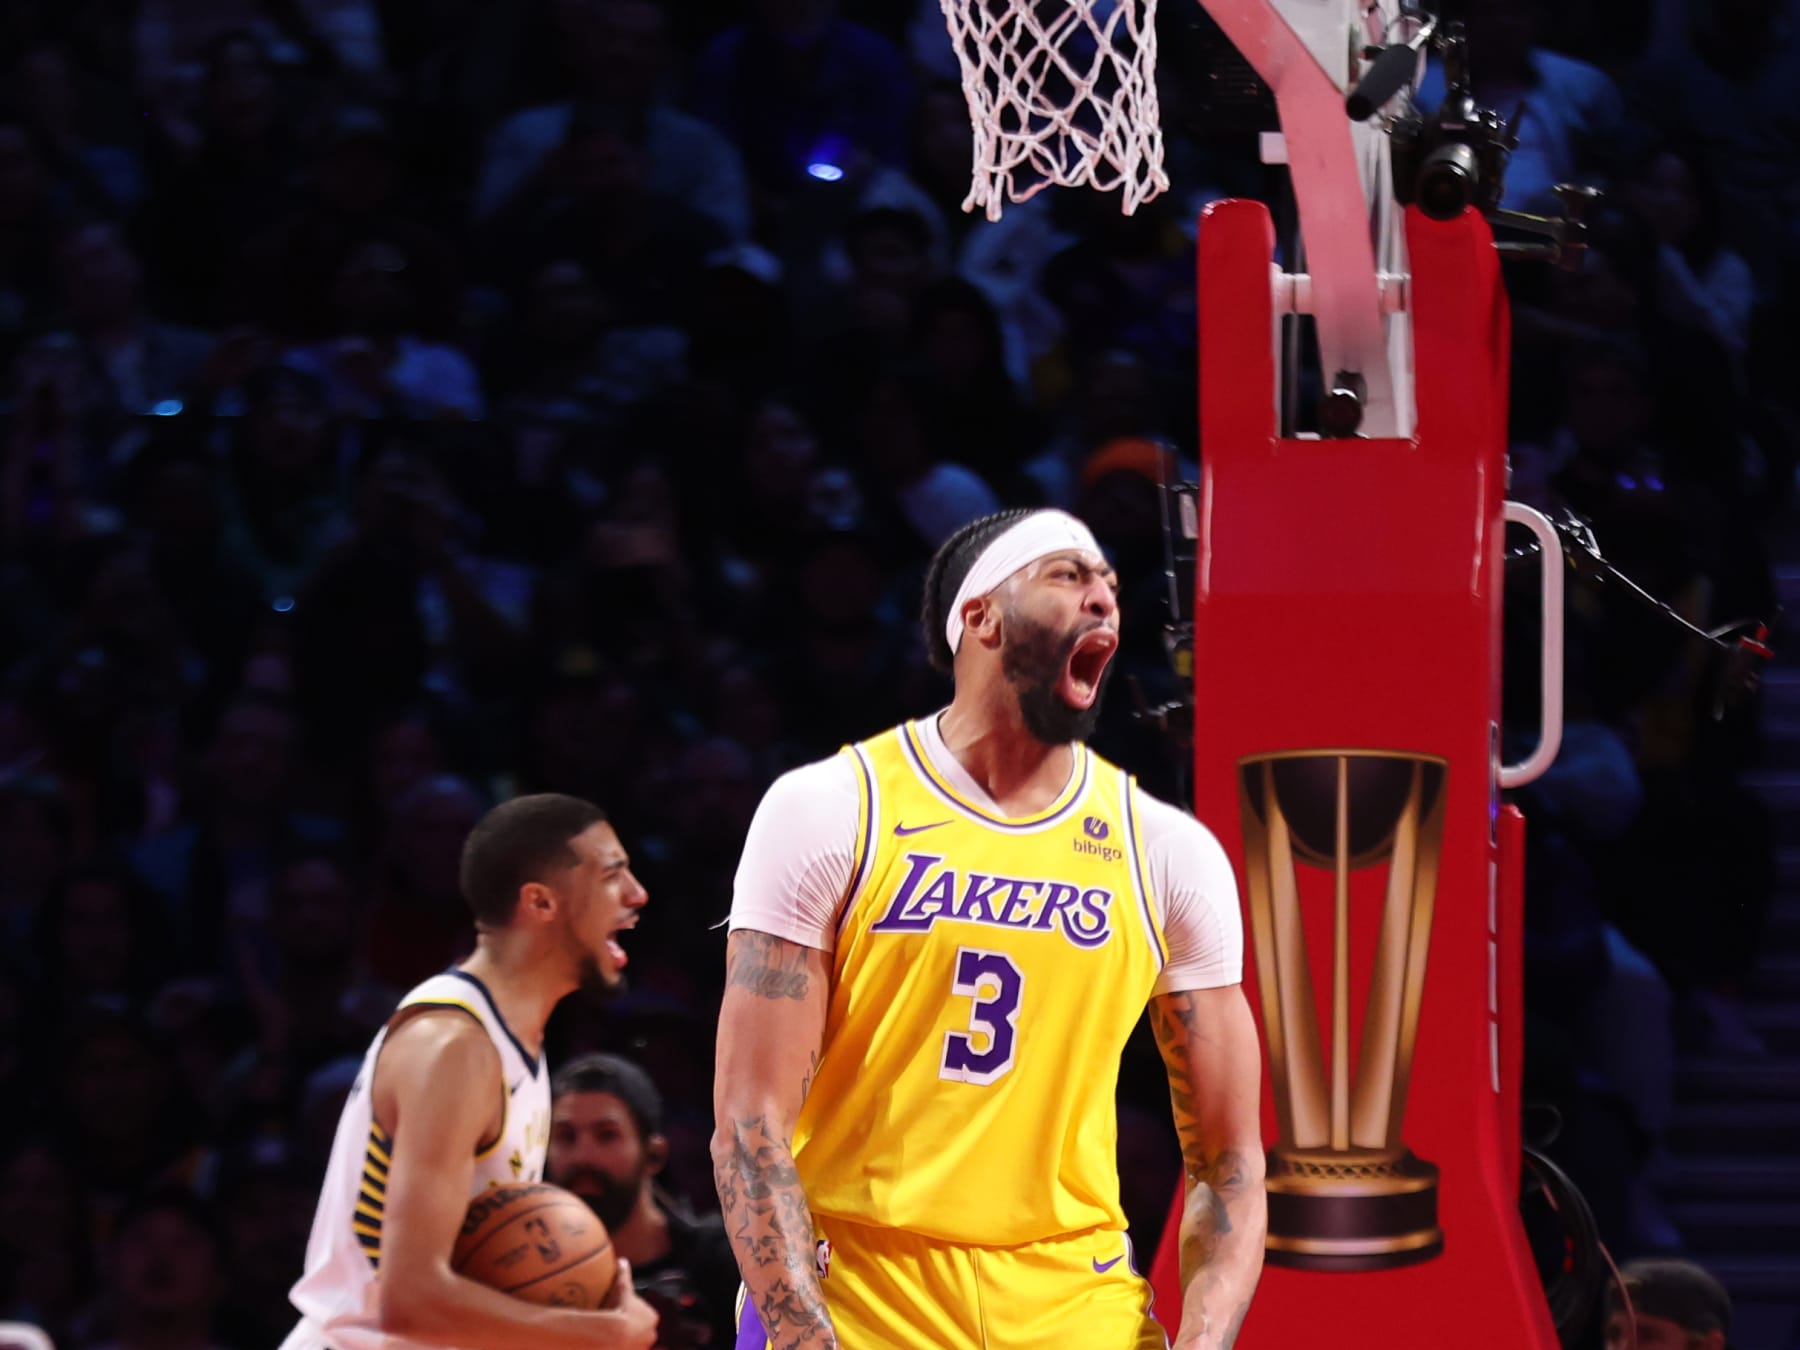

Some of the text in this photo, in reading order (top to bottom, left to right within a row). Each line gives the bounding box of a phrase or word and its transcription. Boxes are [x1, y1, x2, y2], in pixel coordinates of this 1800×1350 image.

[1073, 838, 1122, 862] bibigo
[869, 852, 1113, 949] LAKERS
[939, 946, 1025, 1086] 3
